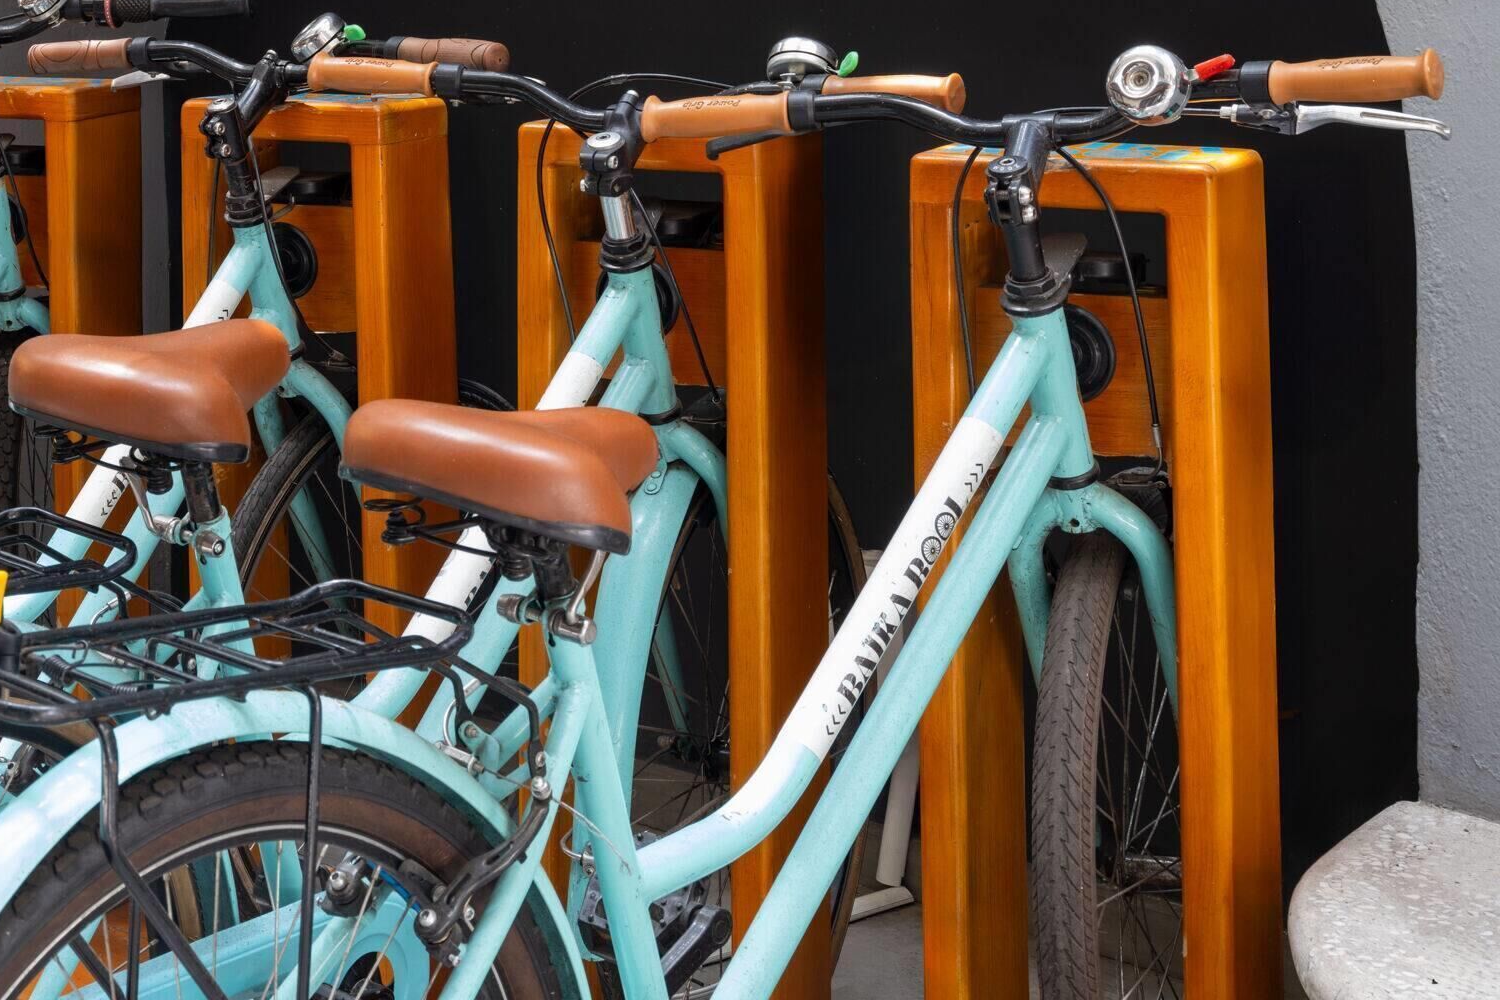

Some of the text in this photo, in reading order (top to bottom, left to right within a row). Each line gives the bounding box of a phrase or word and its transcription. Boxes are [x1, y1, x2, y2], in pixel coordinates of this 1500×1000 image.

[682, 99, 741, 110] Power Grip
[837, 593, 913, 706] BAIKA
